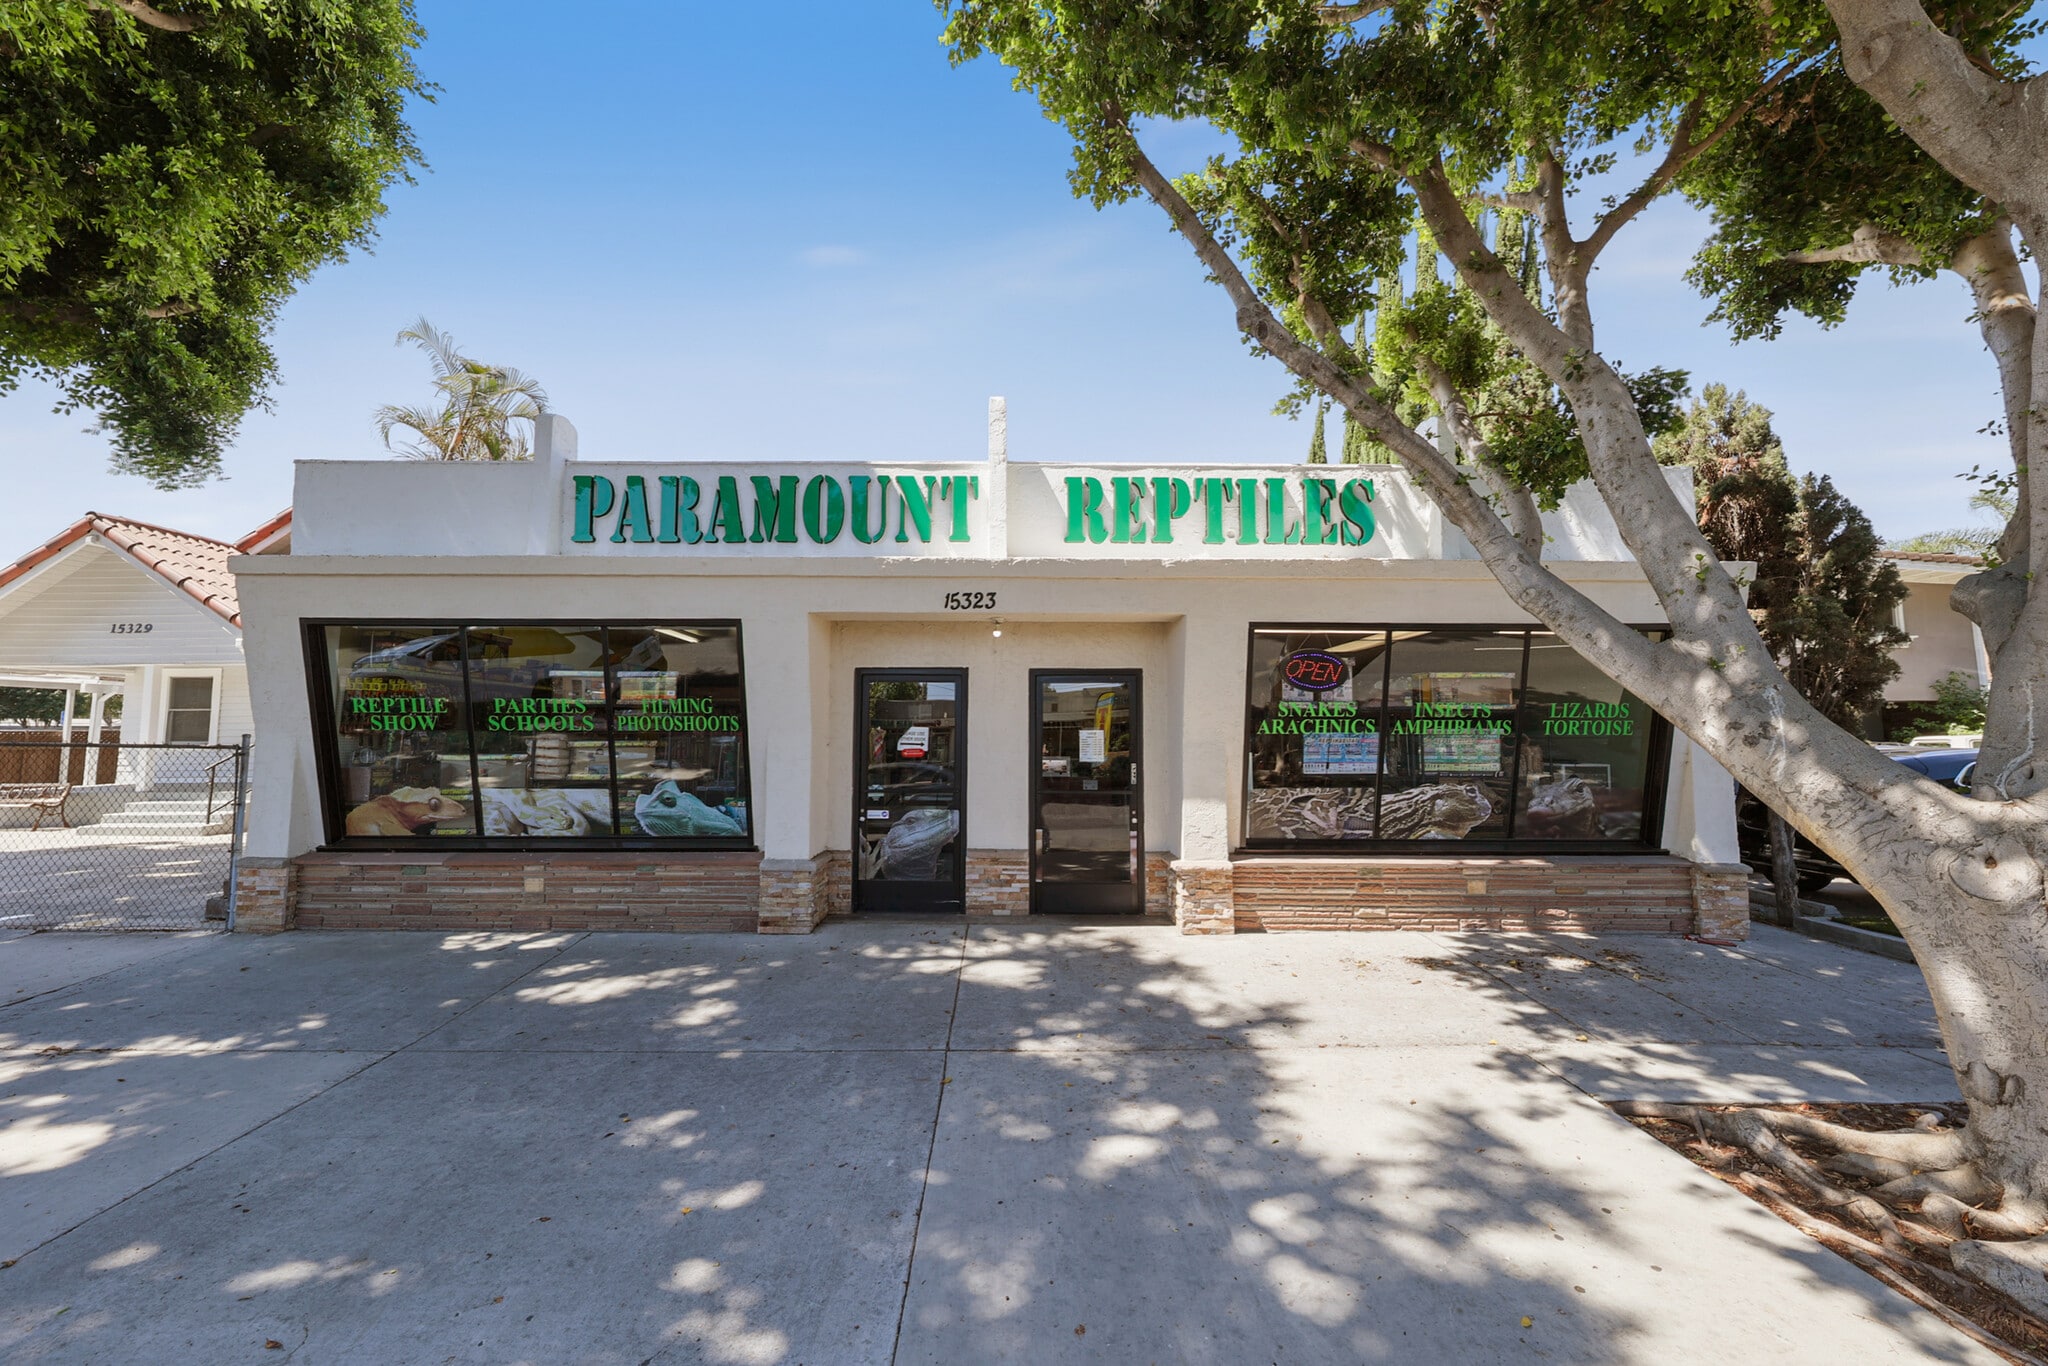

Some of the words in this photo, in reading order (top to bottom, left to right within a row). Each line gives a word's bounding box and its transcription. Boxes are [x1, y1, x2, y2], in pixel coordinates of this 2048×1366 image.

[571, 474, 979, 544] PARAMOUNT
[1063, 476, 1376, 546] REPTILES
[944, 591, 997, 610] 15323
[110, 623, 153, 634] 15329
[1285, 659, 1343, 682] OPEN
[352, 697, 448, 713] REPTILE
[494, 698, 587, 714] PARTIES
[642, 698, 713, 714] FILMING
[1278, 701, 1357, 717] SNAKES
[1415, 702, 1492, 718] INSECTS
[1550, 702, 1630, 718] LIZARDS
[370, 715, 438, 731] SHOW
[488, 715, 595, 732] SCHOOLS
[617, 715, 740, 732] PHOTOSHOOTS
[1543, 720, 1634, 736] TORTOISE
